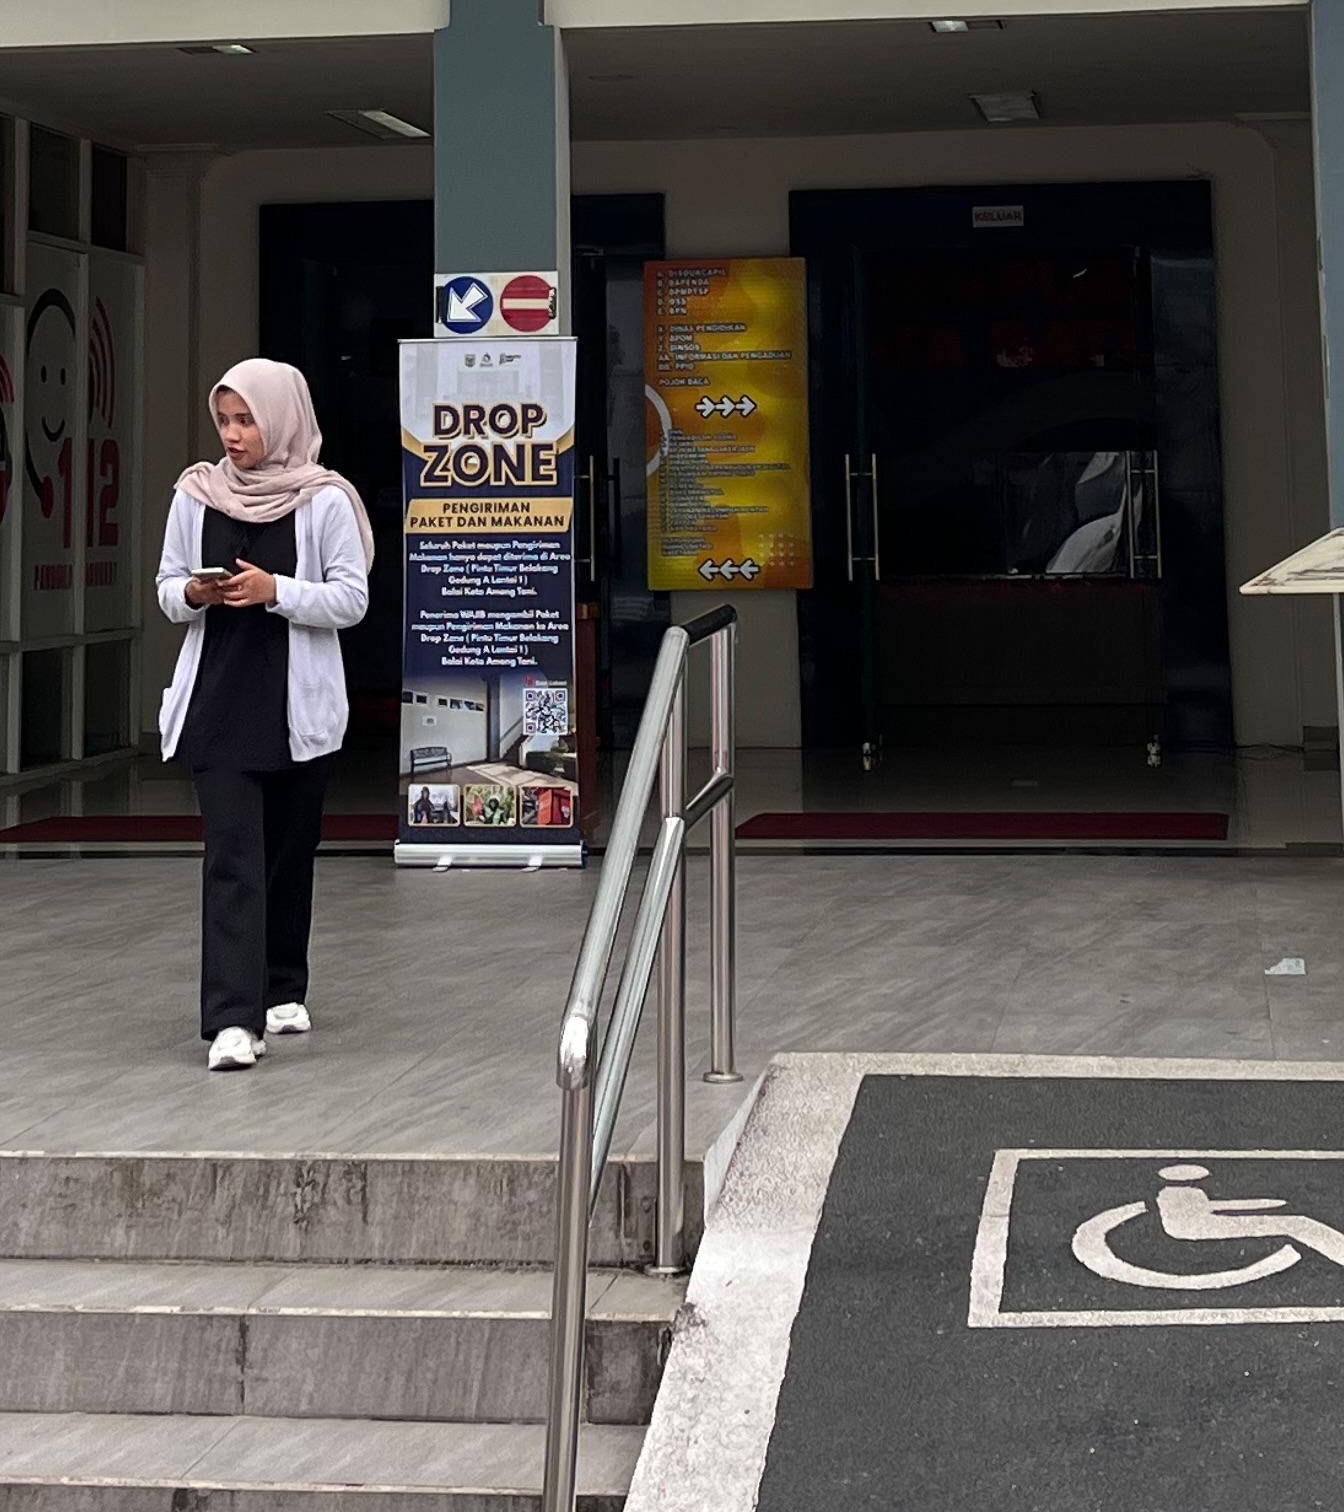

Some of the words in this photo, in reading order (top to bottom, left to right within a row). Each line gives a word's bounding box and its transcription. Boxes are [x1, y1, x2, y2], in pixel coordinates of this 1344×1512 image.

[432, 402, 547, 439] DROP
[420, 441, 558, 487] ZONE
[443, 502, 530, 514] PENGIRIMAN
[410, 516, 453, 528] PAKET
[456, 516, 487, 528] DAN
[491, 515, 565, 528] MAKANAN
